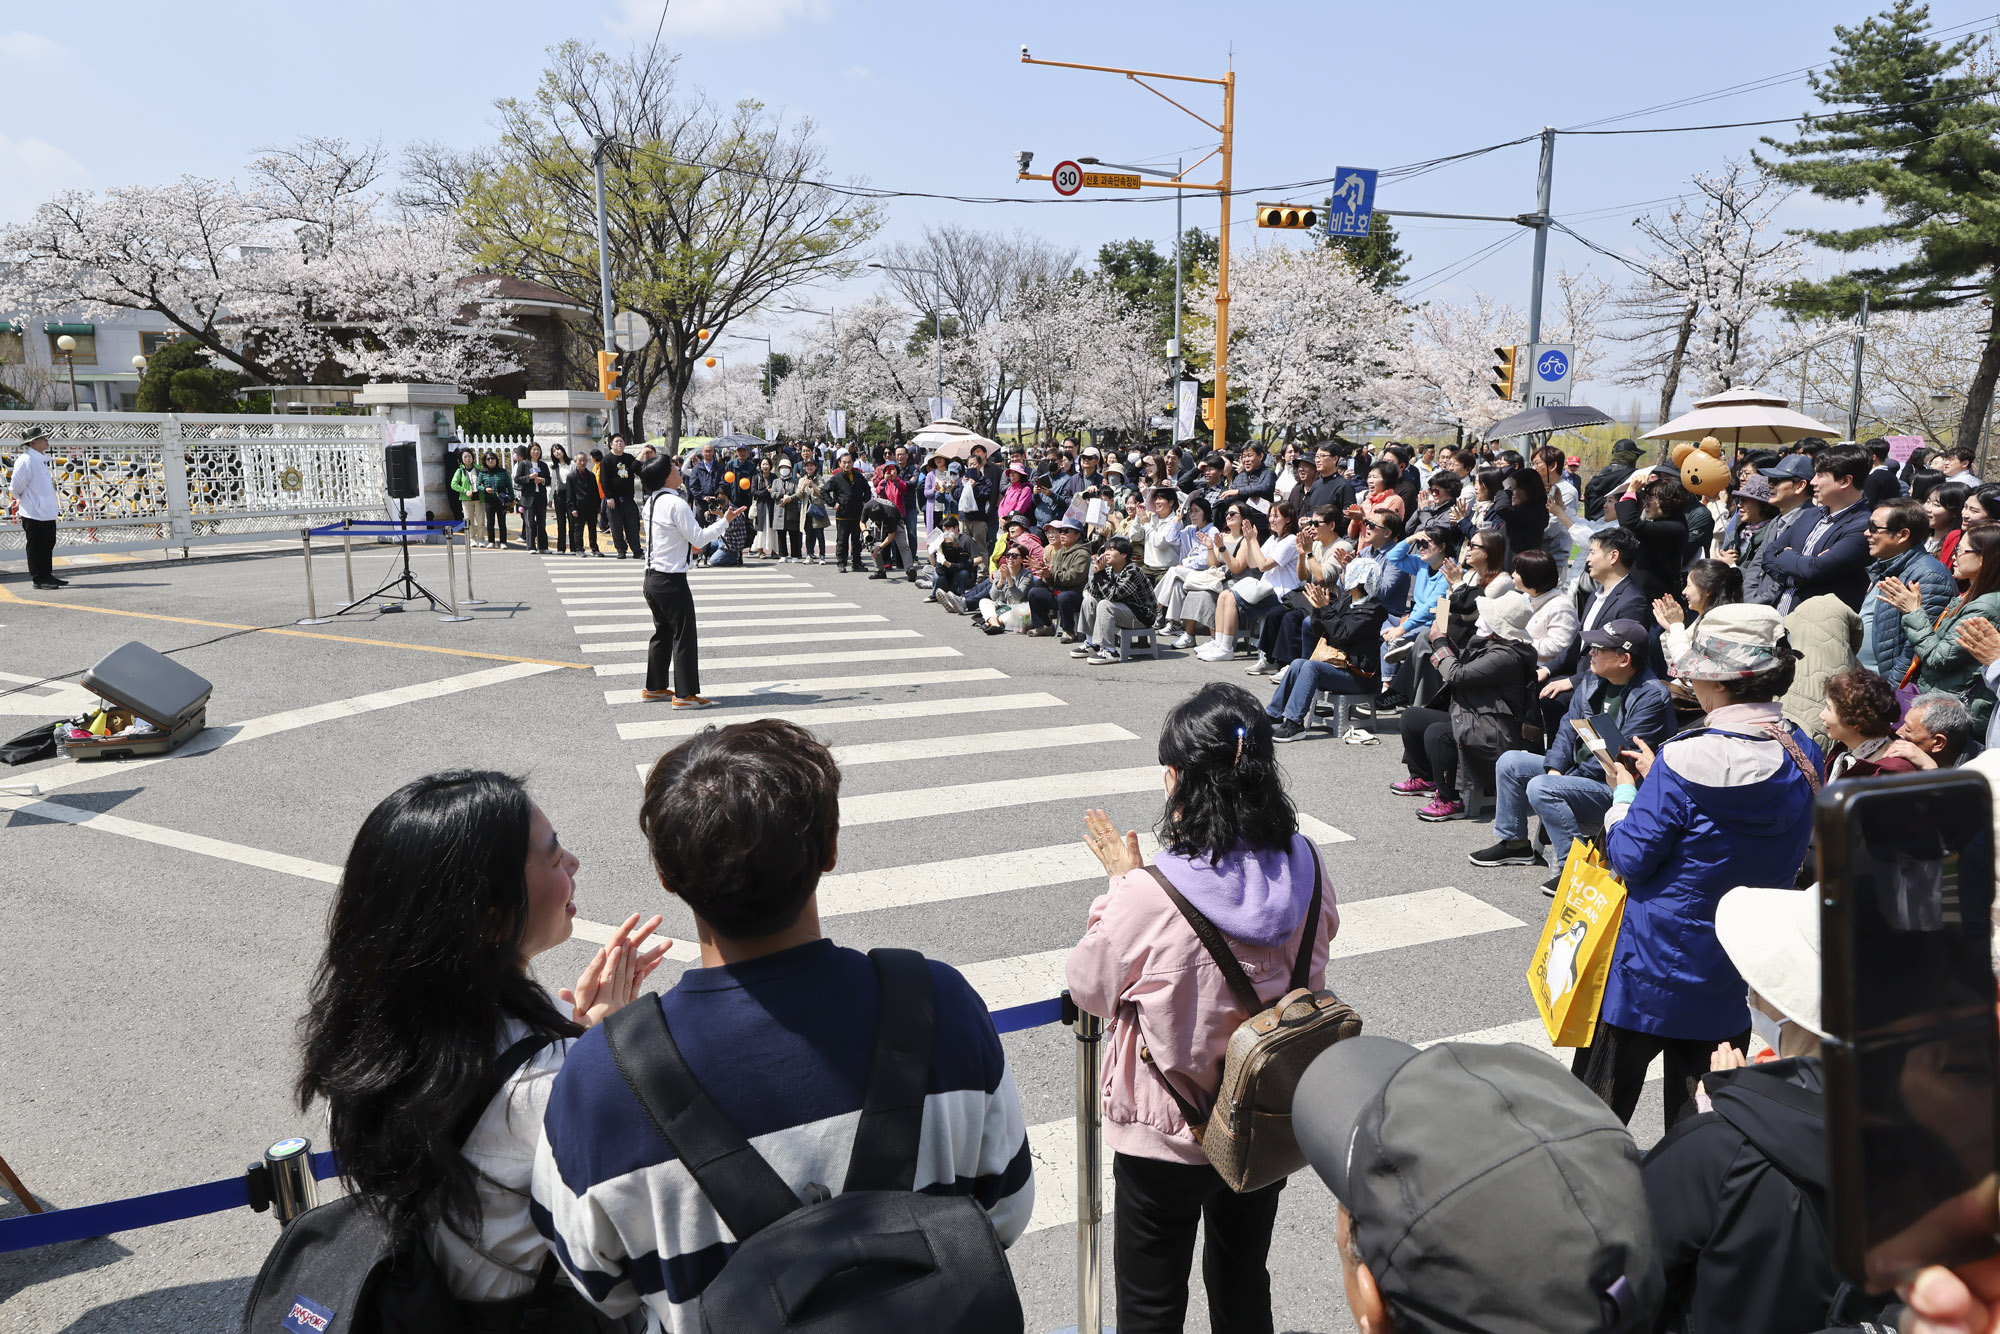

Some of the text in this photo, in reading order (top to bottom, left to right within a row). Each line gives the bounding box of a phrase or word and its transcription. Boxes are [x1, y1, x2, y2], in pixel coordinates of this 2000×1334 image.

[1059, 171, 1077, 186] 30
[1086, 175, 1139, 187] 신호 과속단속장비
[1330, 211, 1368, 233] 비보호
[1570, 874, 1608, 912] HORT
[288, 1303, 328, 1332] JANSPORT
